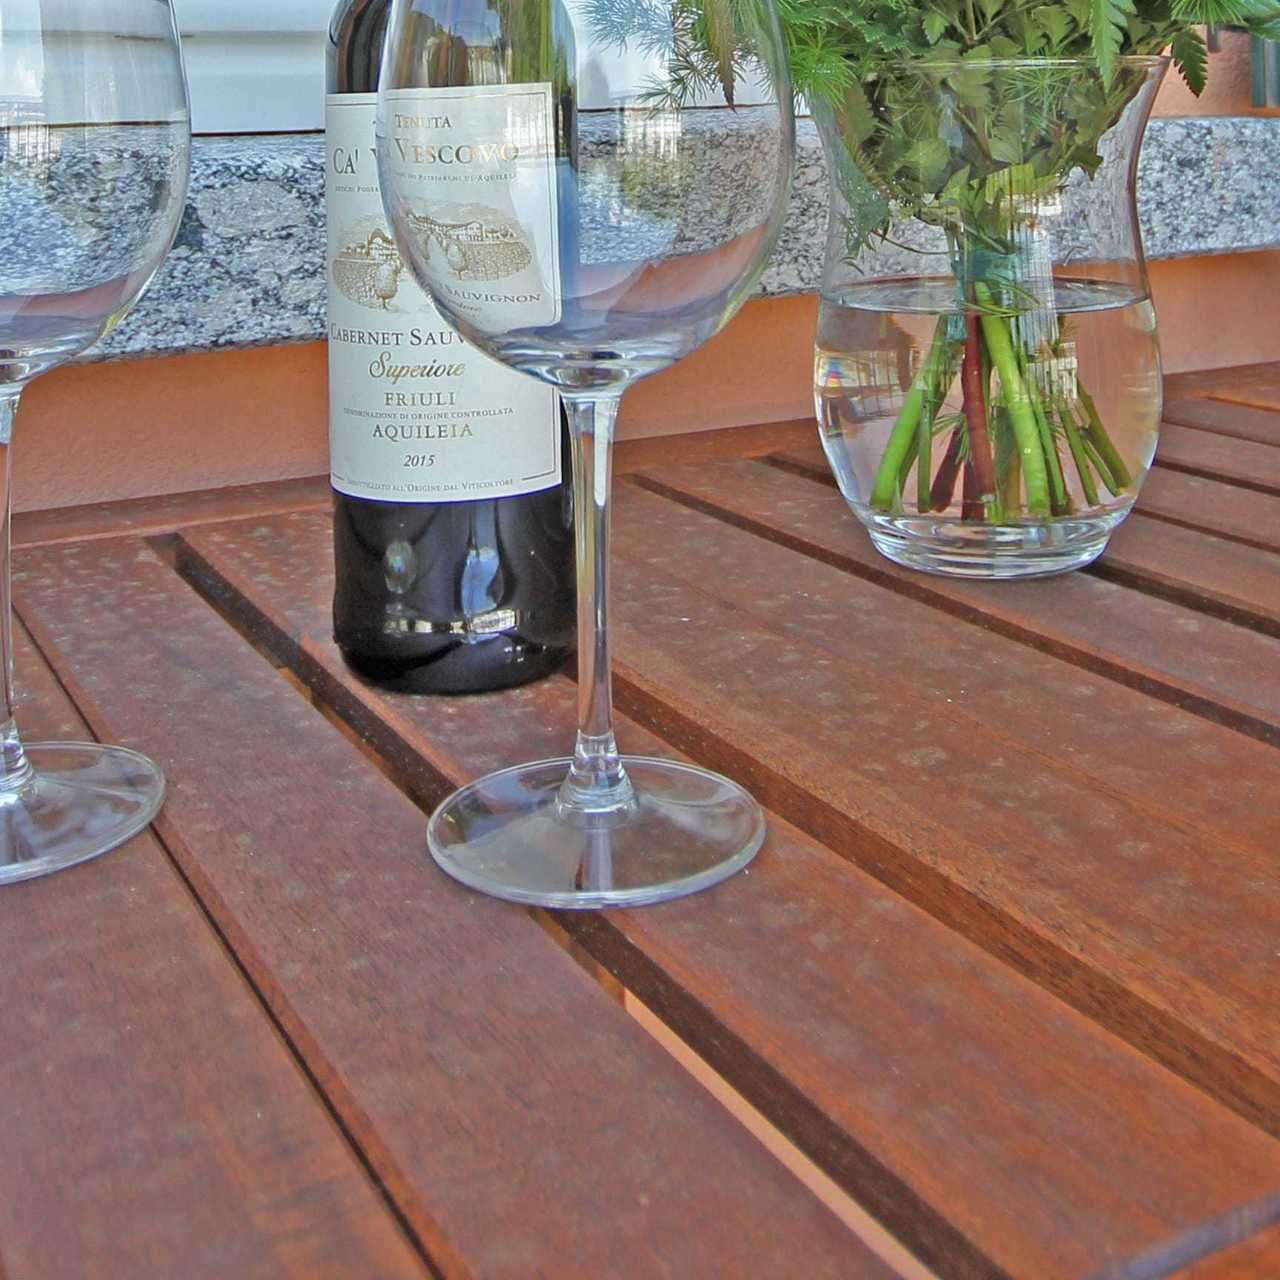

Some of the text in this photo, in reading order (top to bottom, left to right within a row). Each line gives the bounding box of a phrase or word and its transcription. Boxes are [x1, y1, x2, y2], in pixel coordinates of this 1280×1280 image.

[395, 113, 452, 129] TENUTA
[333, 137, 520, 174] CA' VESCOVO
[330, 323, 465, 346] CABERNET SAUV
[369, 351, 466, 385] Superiore
[384, 391, 457, 407] FRIULI
[399, 410, 410, 420] DI
[411, 410, 449, 420] ORIGINE
[451, 407, 514, 419] CONTROLLATA
[372, 423, 473, 442] AQUILEIA
[403, 454, 435, 467] 2015
